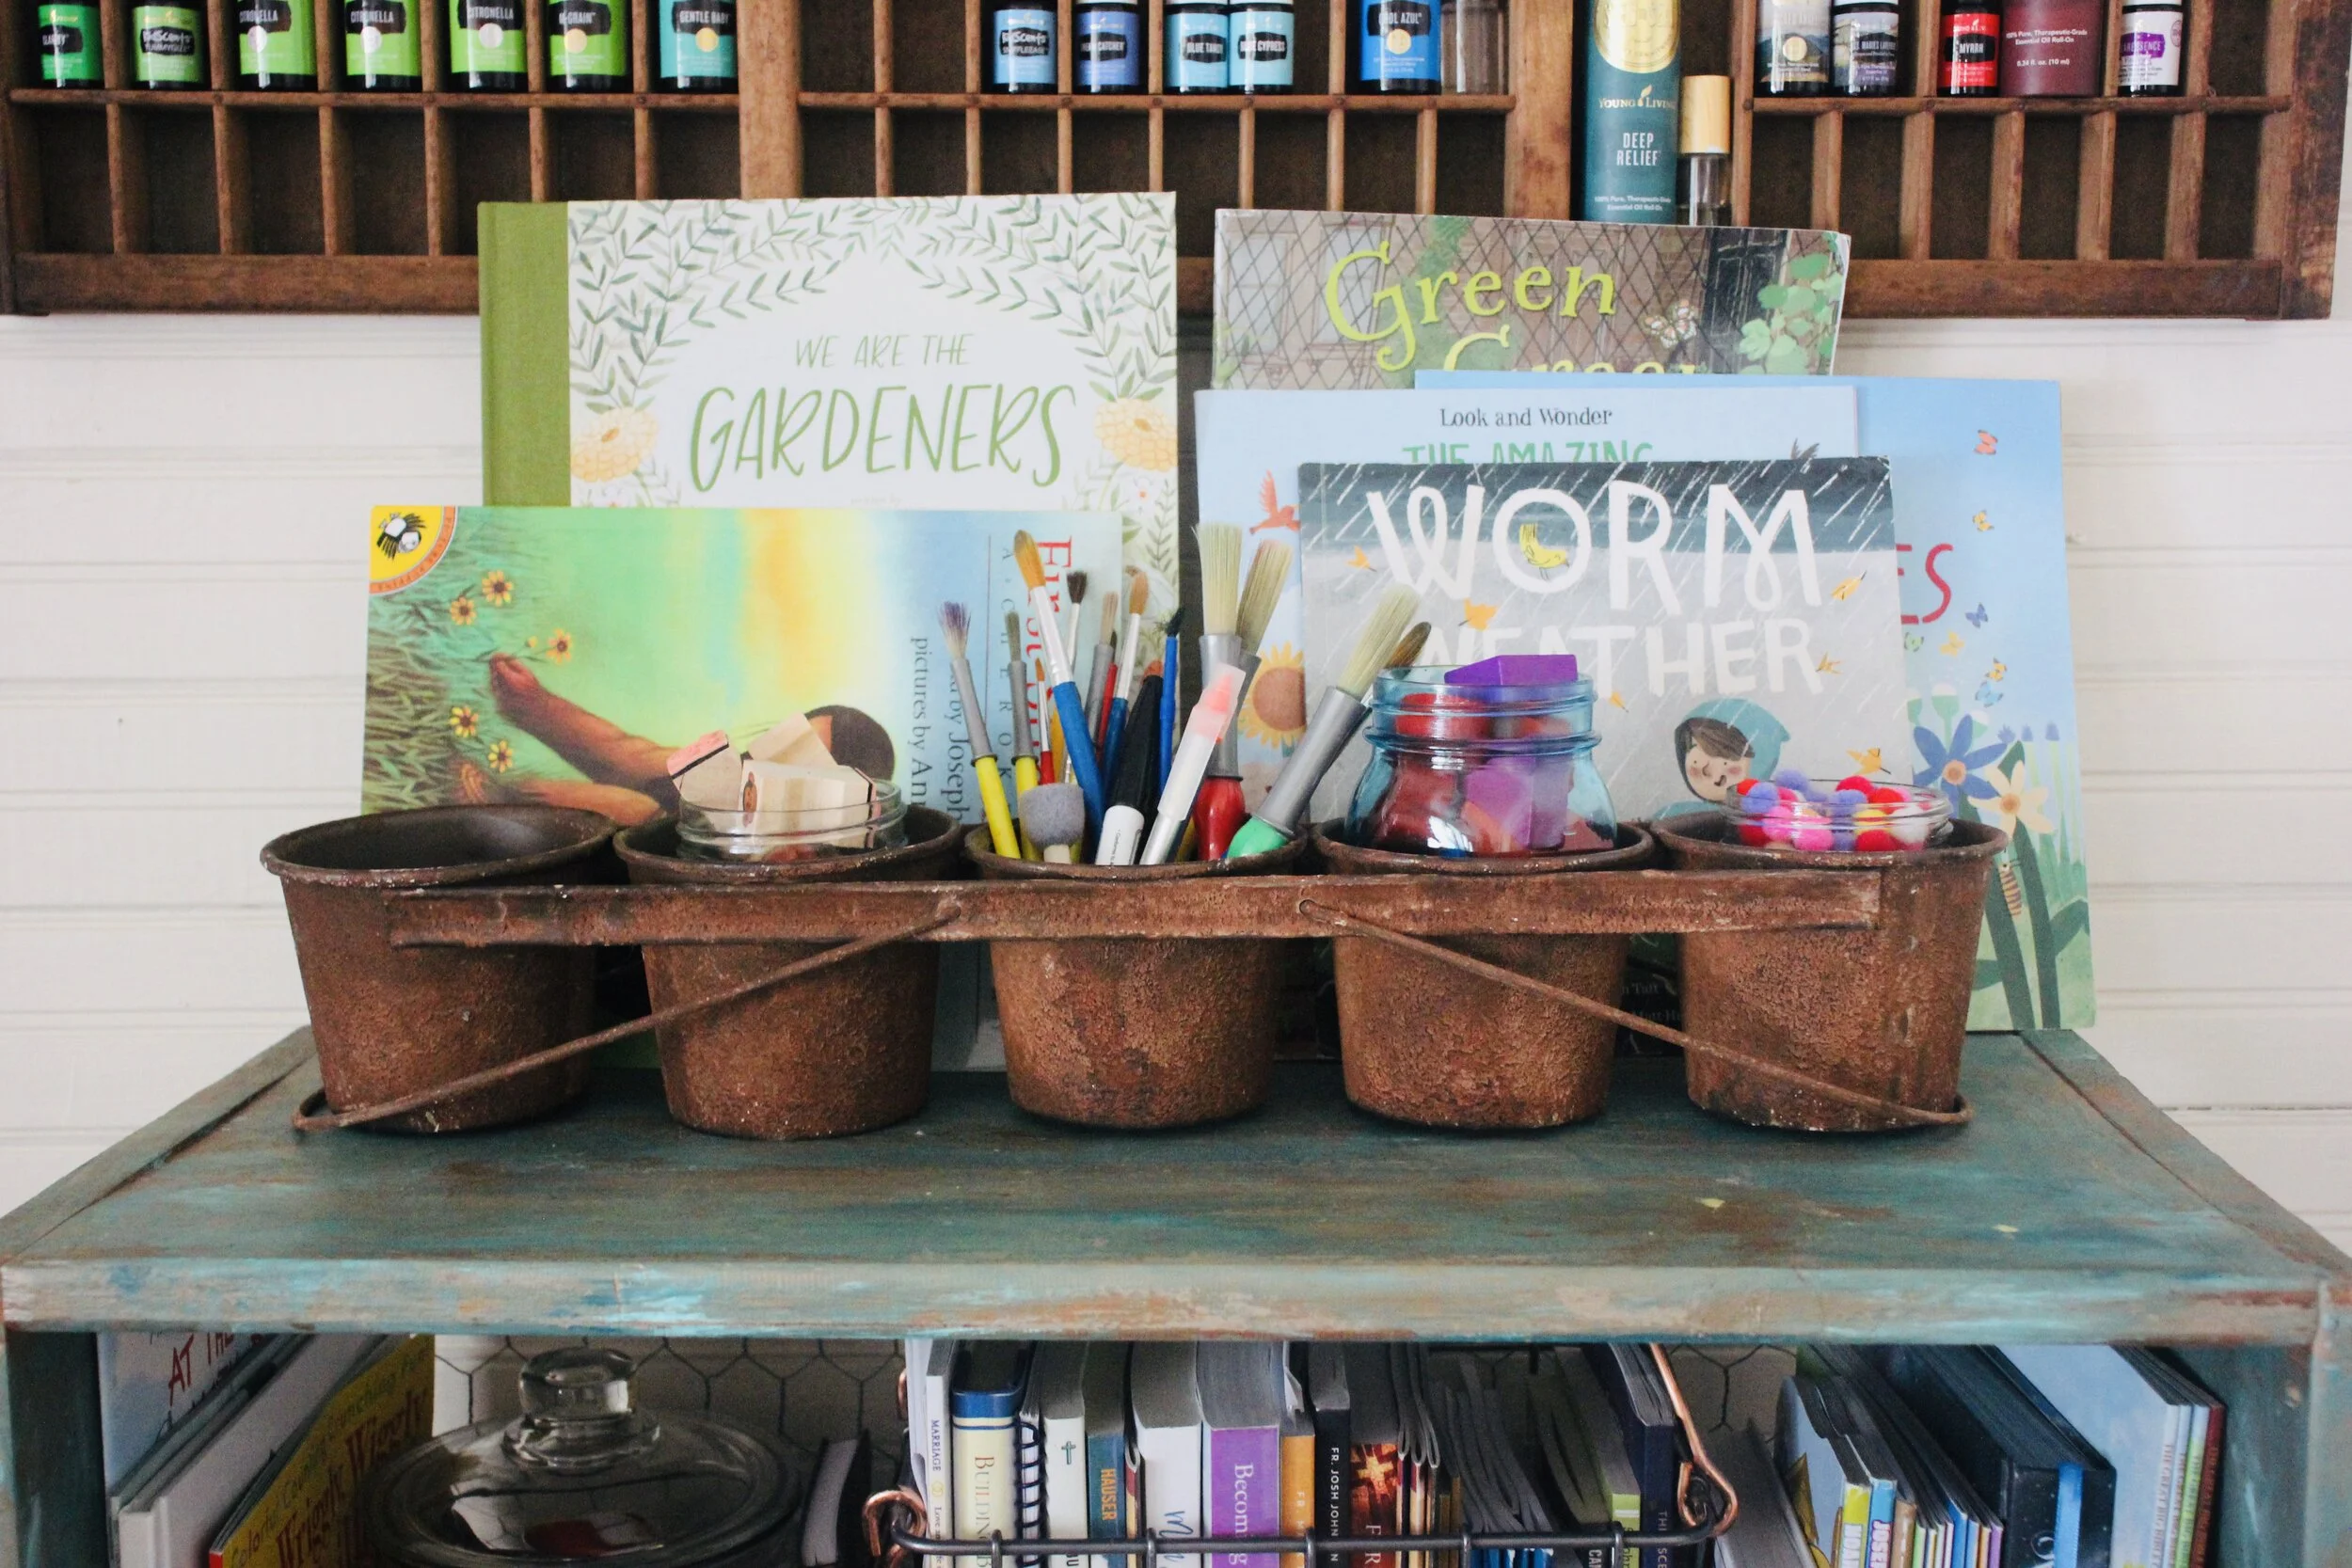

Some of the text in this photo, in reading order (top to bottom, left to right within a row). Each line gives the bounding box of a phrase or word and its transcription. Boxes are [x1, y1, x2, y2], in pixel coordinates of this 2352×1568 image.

[468, 6, 514, 20] CITRONELLA
[678, 9, 709, 24] GENTLE
[1959, 43, 1984, 54] MYRRH
[1598, 97, 1636, 109] YOUNG
[1616, 149, 1660, 166] RELIEF
[1623, 132, 1655, 149] DEEP
[1325, 239, 1617, 372] Green
[796, 332, 975, 369] WE ARE THE
[689, 382, 1077, 494] GARDENERS
[1439, 405, 1613, 428] Look and Wonder
[1364, 482, 1823, 617] WORM
[910, 636, 933, 721] pictures
[907, 724, 931, 751] by
[167, 1334, 195, 1408] AT
[930, 1419, 942, 1472] MARRIAGE
[1100, 1467, 1118, 1521] HAUSER
[1227, 1462, 1255, 1566] Becomg
[1330, 1447, 1340, 1561] FR. JOSH JOHNN
